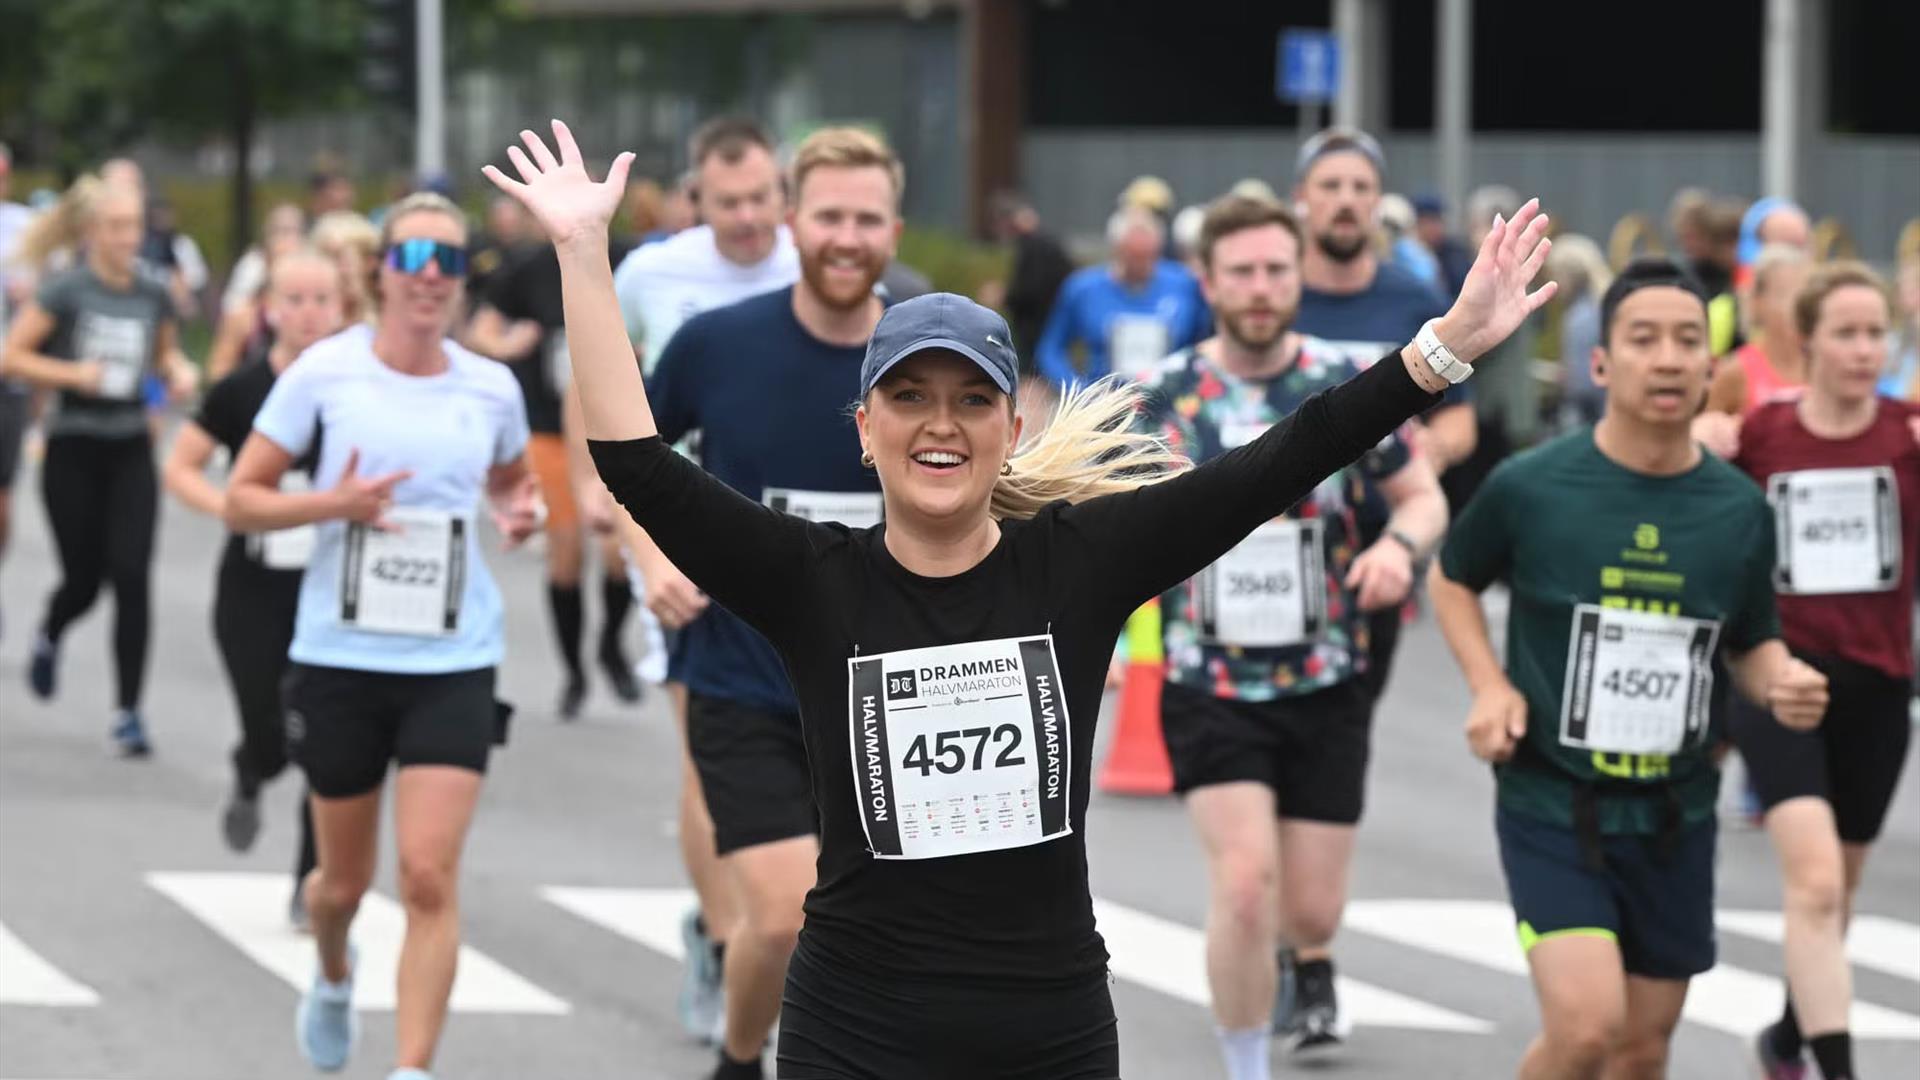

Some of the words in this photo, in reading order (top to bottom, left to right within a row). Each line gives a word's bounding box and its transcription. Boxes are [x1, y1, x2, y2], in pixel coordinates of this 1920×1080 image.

[371, 556, 440, 585] 4222
[920, 657, 1019, 682] DRAMMEN
[1602, 668, 1680, 699] 4507
[922, 675, 1022, 697] HALVMARATON
[902, 723, 1026, 777] 4572
[1036, 675, 1059, 799] HALVMARATON
[863, 695, 888, 822] HALVMARATON
